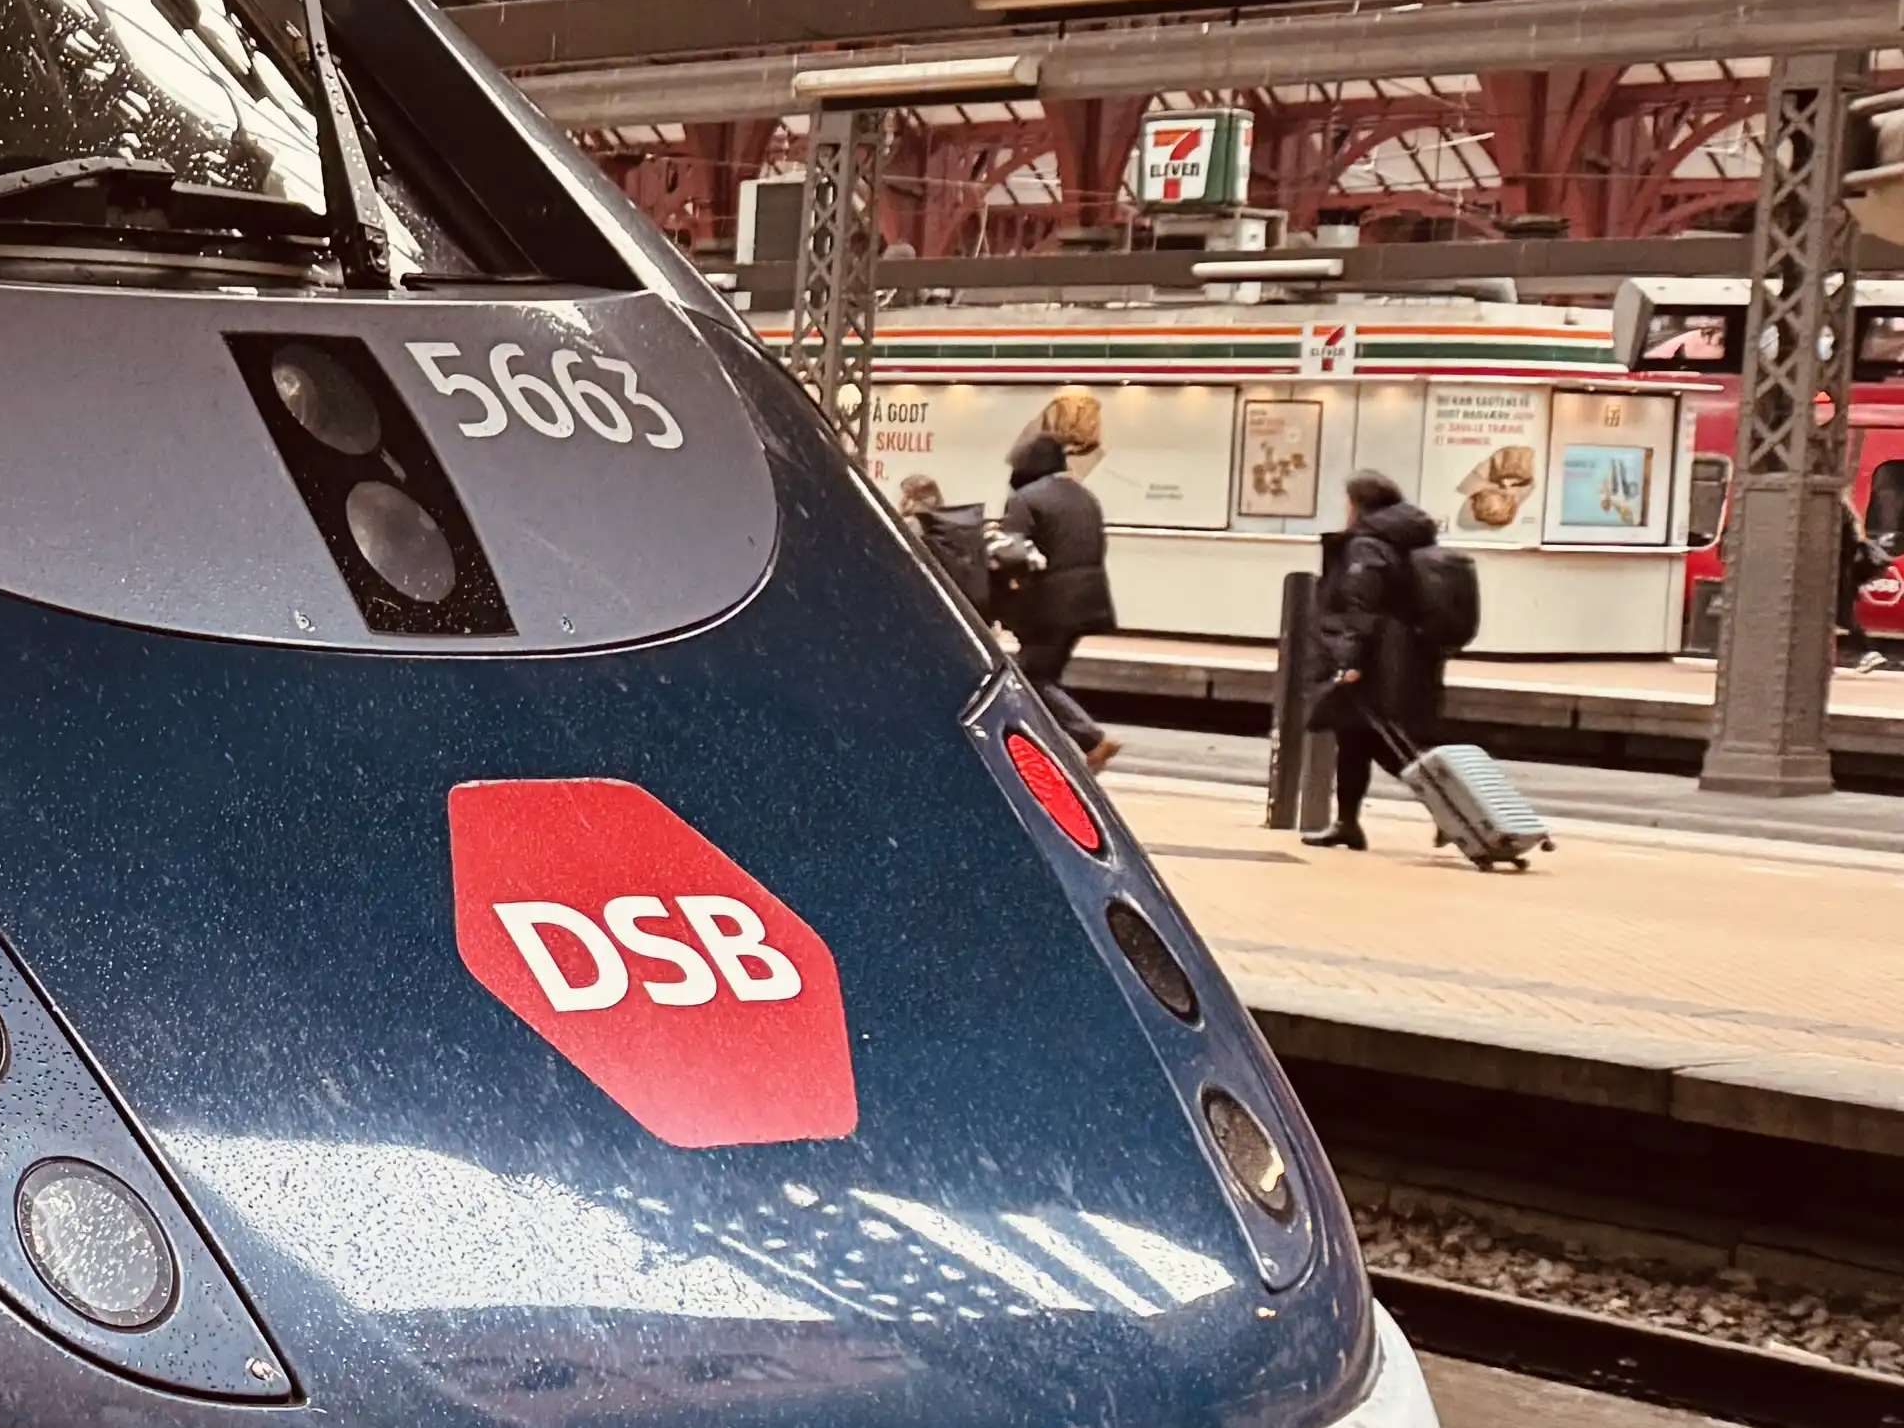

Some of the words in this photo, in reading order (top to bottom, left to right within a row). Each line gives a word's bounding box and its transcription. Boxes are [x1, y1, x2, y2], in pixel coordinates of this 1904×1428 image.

[1153, 127, 1202, 200] 7
[404, 341, 685, 451] 5663
[887, 403, 929, 423] GODT
[876, 432, 934, 453] SKULLE
[492, 895, 802, 1012] DSB
